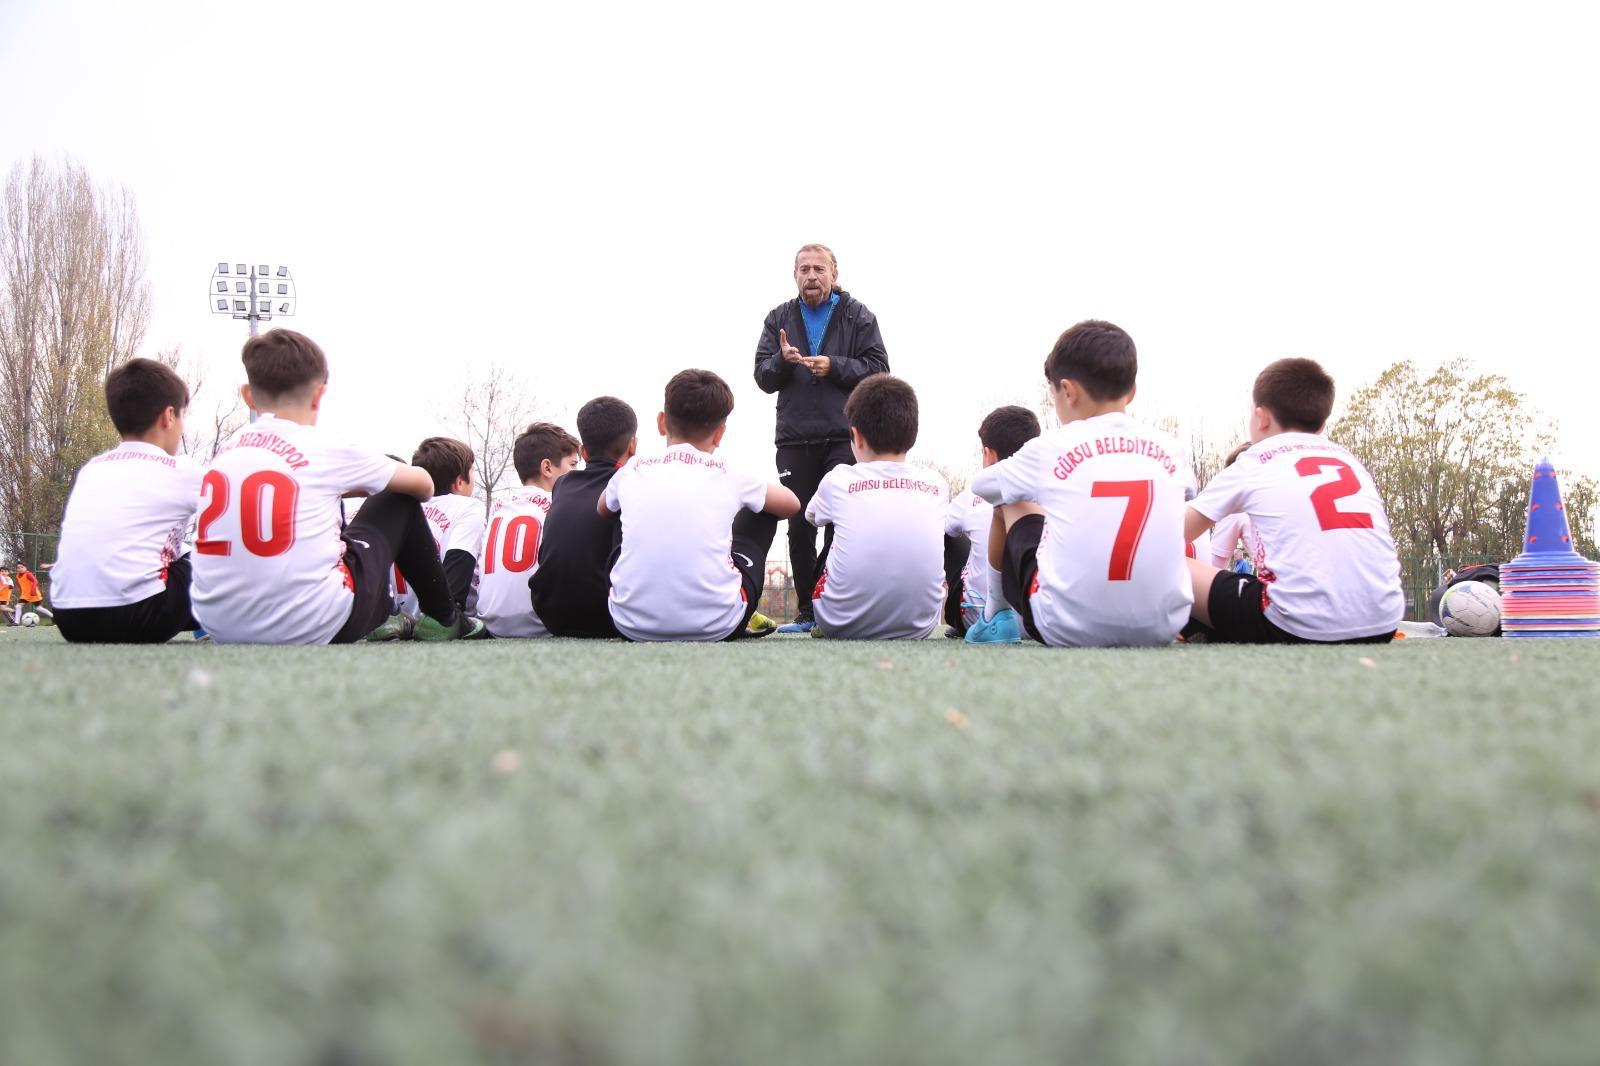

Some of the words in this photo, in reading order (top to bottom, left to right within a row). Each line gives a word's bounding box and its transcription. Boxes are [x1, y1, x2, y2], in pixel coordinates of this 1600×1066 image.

[1054, 442, 1093, 480] GÜRSU
[1096, 437, 1176, 476] BELEDİYESPOR
[1294, 456, 1374, 531] 2
[195, 469, 300, 557] 20
[485, 515, 542, 574] 10
[1091, 480, 1154, 581] 7
